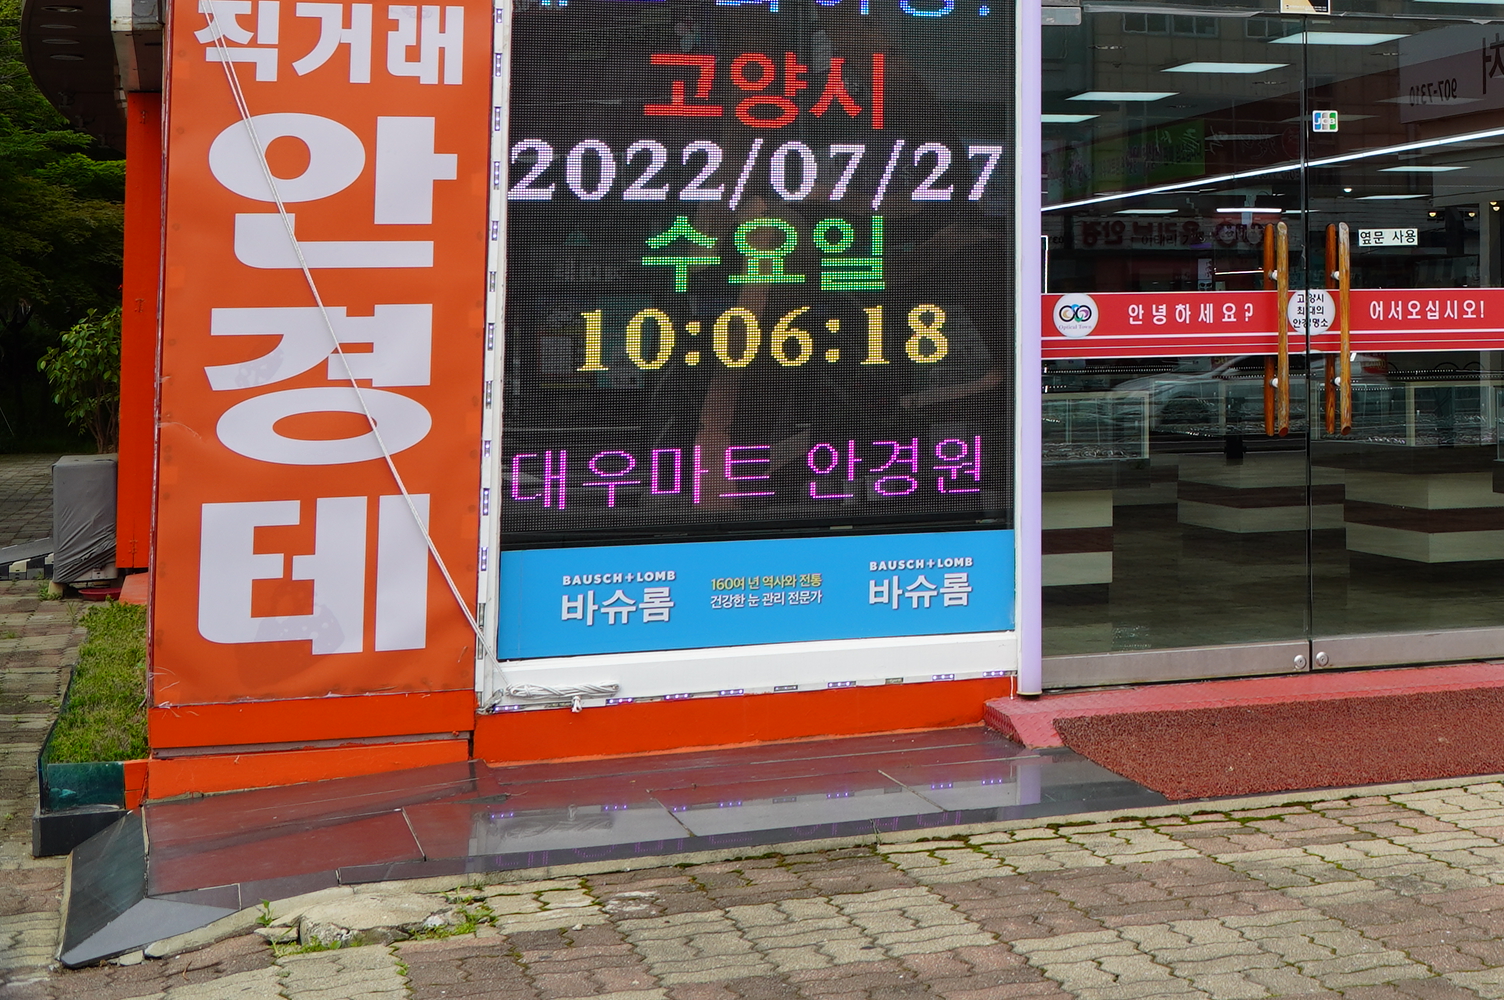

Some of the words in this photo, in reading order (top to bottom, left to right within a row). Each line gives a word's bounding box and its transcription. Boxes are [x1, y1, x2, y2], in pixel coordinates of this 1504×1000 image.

[194, 0, 465, 85] 직거래
[643, 51, 884, 129] 고양시
[507, 138, 1003, 211] 2022/07/27
[642, 215, 886, 293] 수요일
[1360, 230, 1385, 245] 옆문
[1392, 229, 1416, 244] 사용
[1128, 302, 1253, 325] 안녕하세요?
[1370, 300, 1485, 320] 어서오십시오!
[576, 304, 949, 372] 10:06:18
[198, 112, 458, 655] 안경테
[511, 444, 776, 510] 대우마트
[807, 435, 982, 499] 안경원
[562, 570, 676, 586] BAUSCH+LOMB
[710, 577, 745, 591] 160여
[748, 576, 760, 590] 년
[762, 574, 797, 589] 역사와
[799, 573, 822, 588] 전통
[869, 557, 974, 572] BAUSCH+LOMB
[561, 586, 675, 626] 바슈롬
[710, 593, 746, 609] 건강한
[748, 593, 760, 607] 눈
[762, 591, 785, 607] 관리
[787, 589, 822, 606] 전문가
[868, 572, 973, 610] 바슈롬
